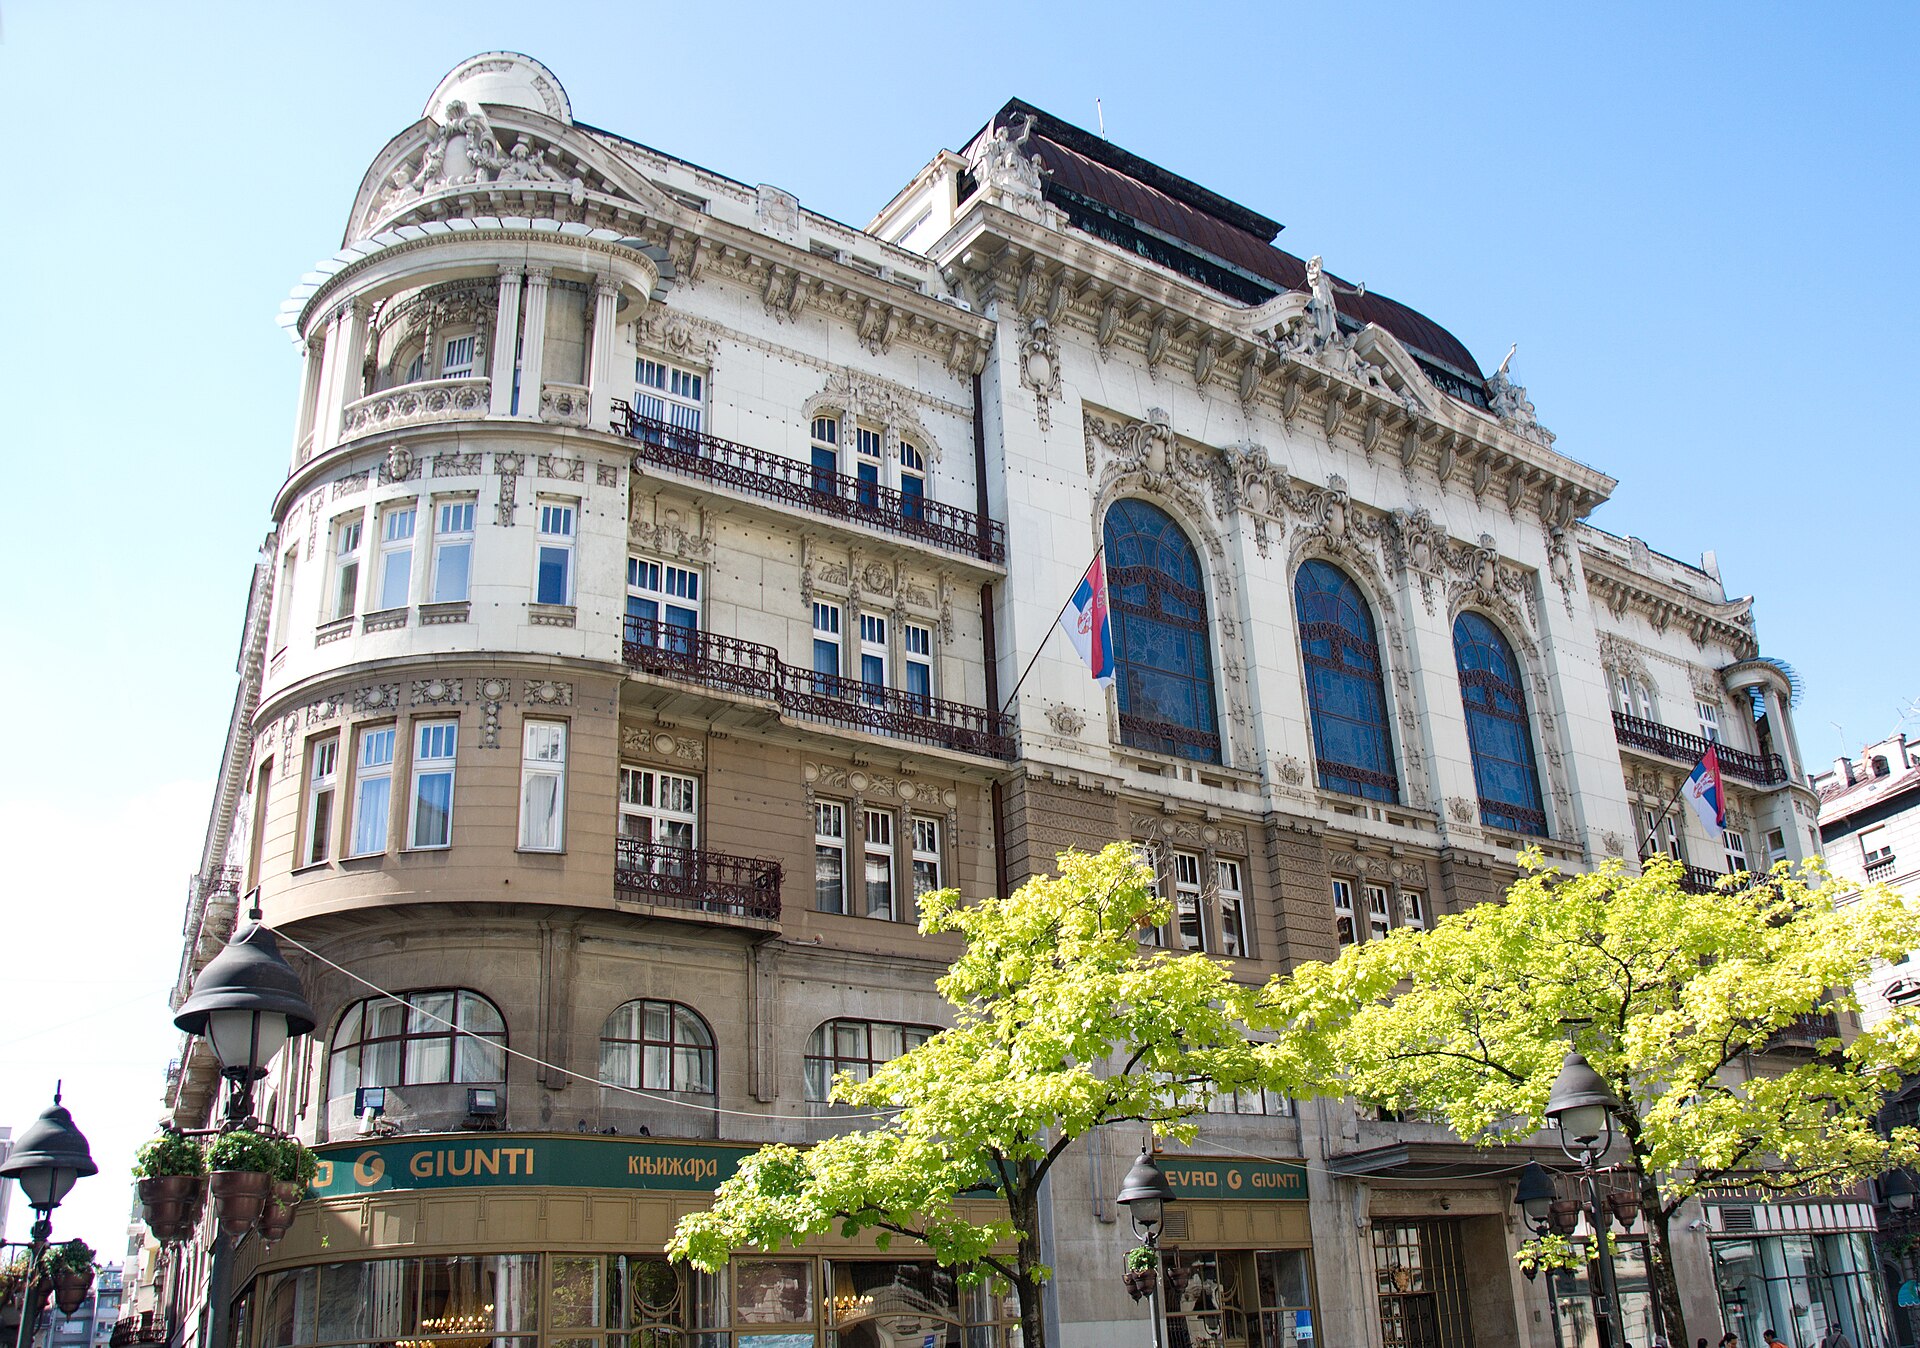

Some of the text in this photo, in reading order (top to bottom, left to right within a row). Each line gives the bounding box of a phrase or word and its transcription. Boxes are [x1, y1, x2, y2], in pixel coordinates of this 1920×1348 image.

[409, 1148, 534, 1178] GIUNTI
[1165, 1170, 1300, 1188] EVRO GIUNTI
